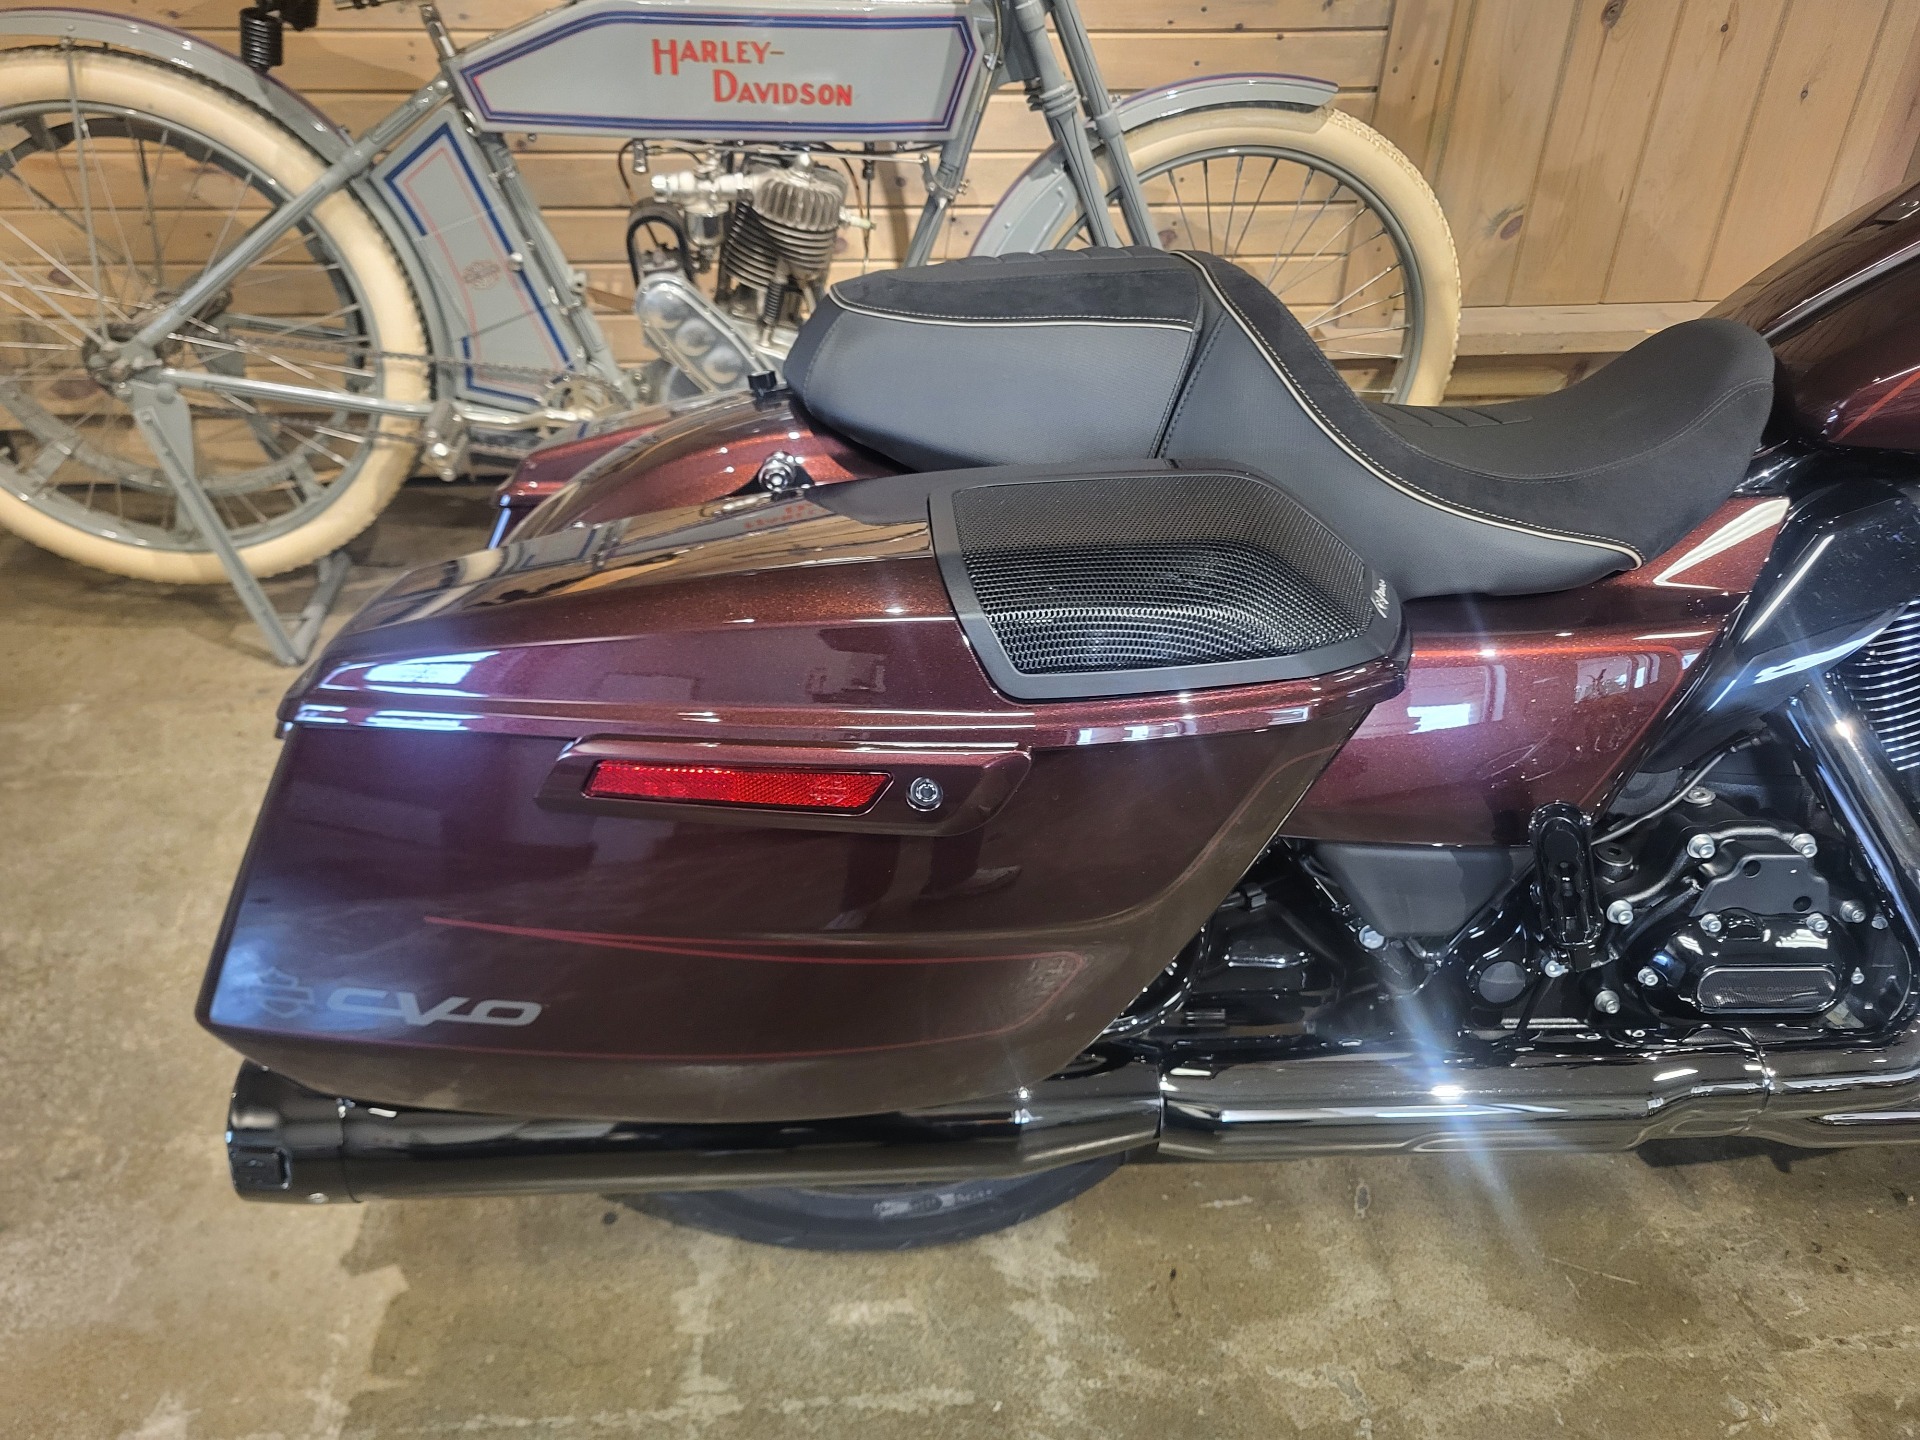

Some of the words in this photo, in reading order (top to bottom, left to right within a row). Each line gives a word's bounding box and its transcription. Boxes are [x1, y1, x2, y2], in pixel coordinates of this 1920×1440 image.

[652, 38, 785, 75] HARLEY-
[713, 69, 852, 106] DAVIDSON
[327, 987, 542, 1027] CVO
